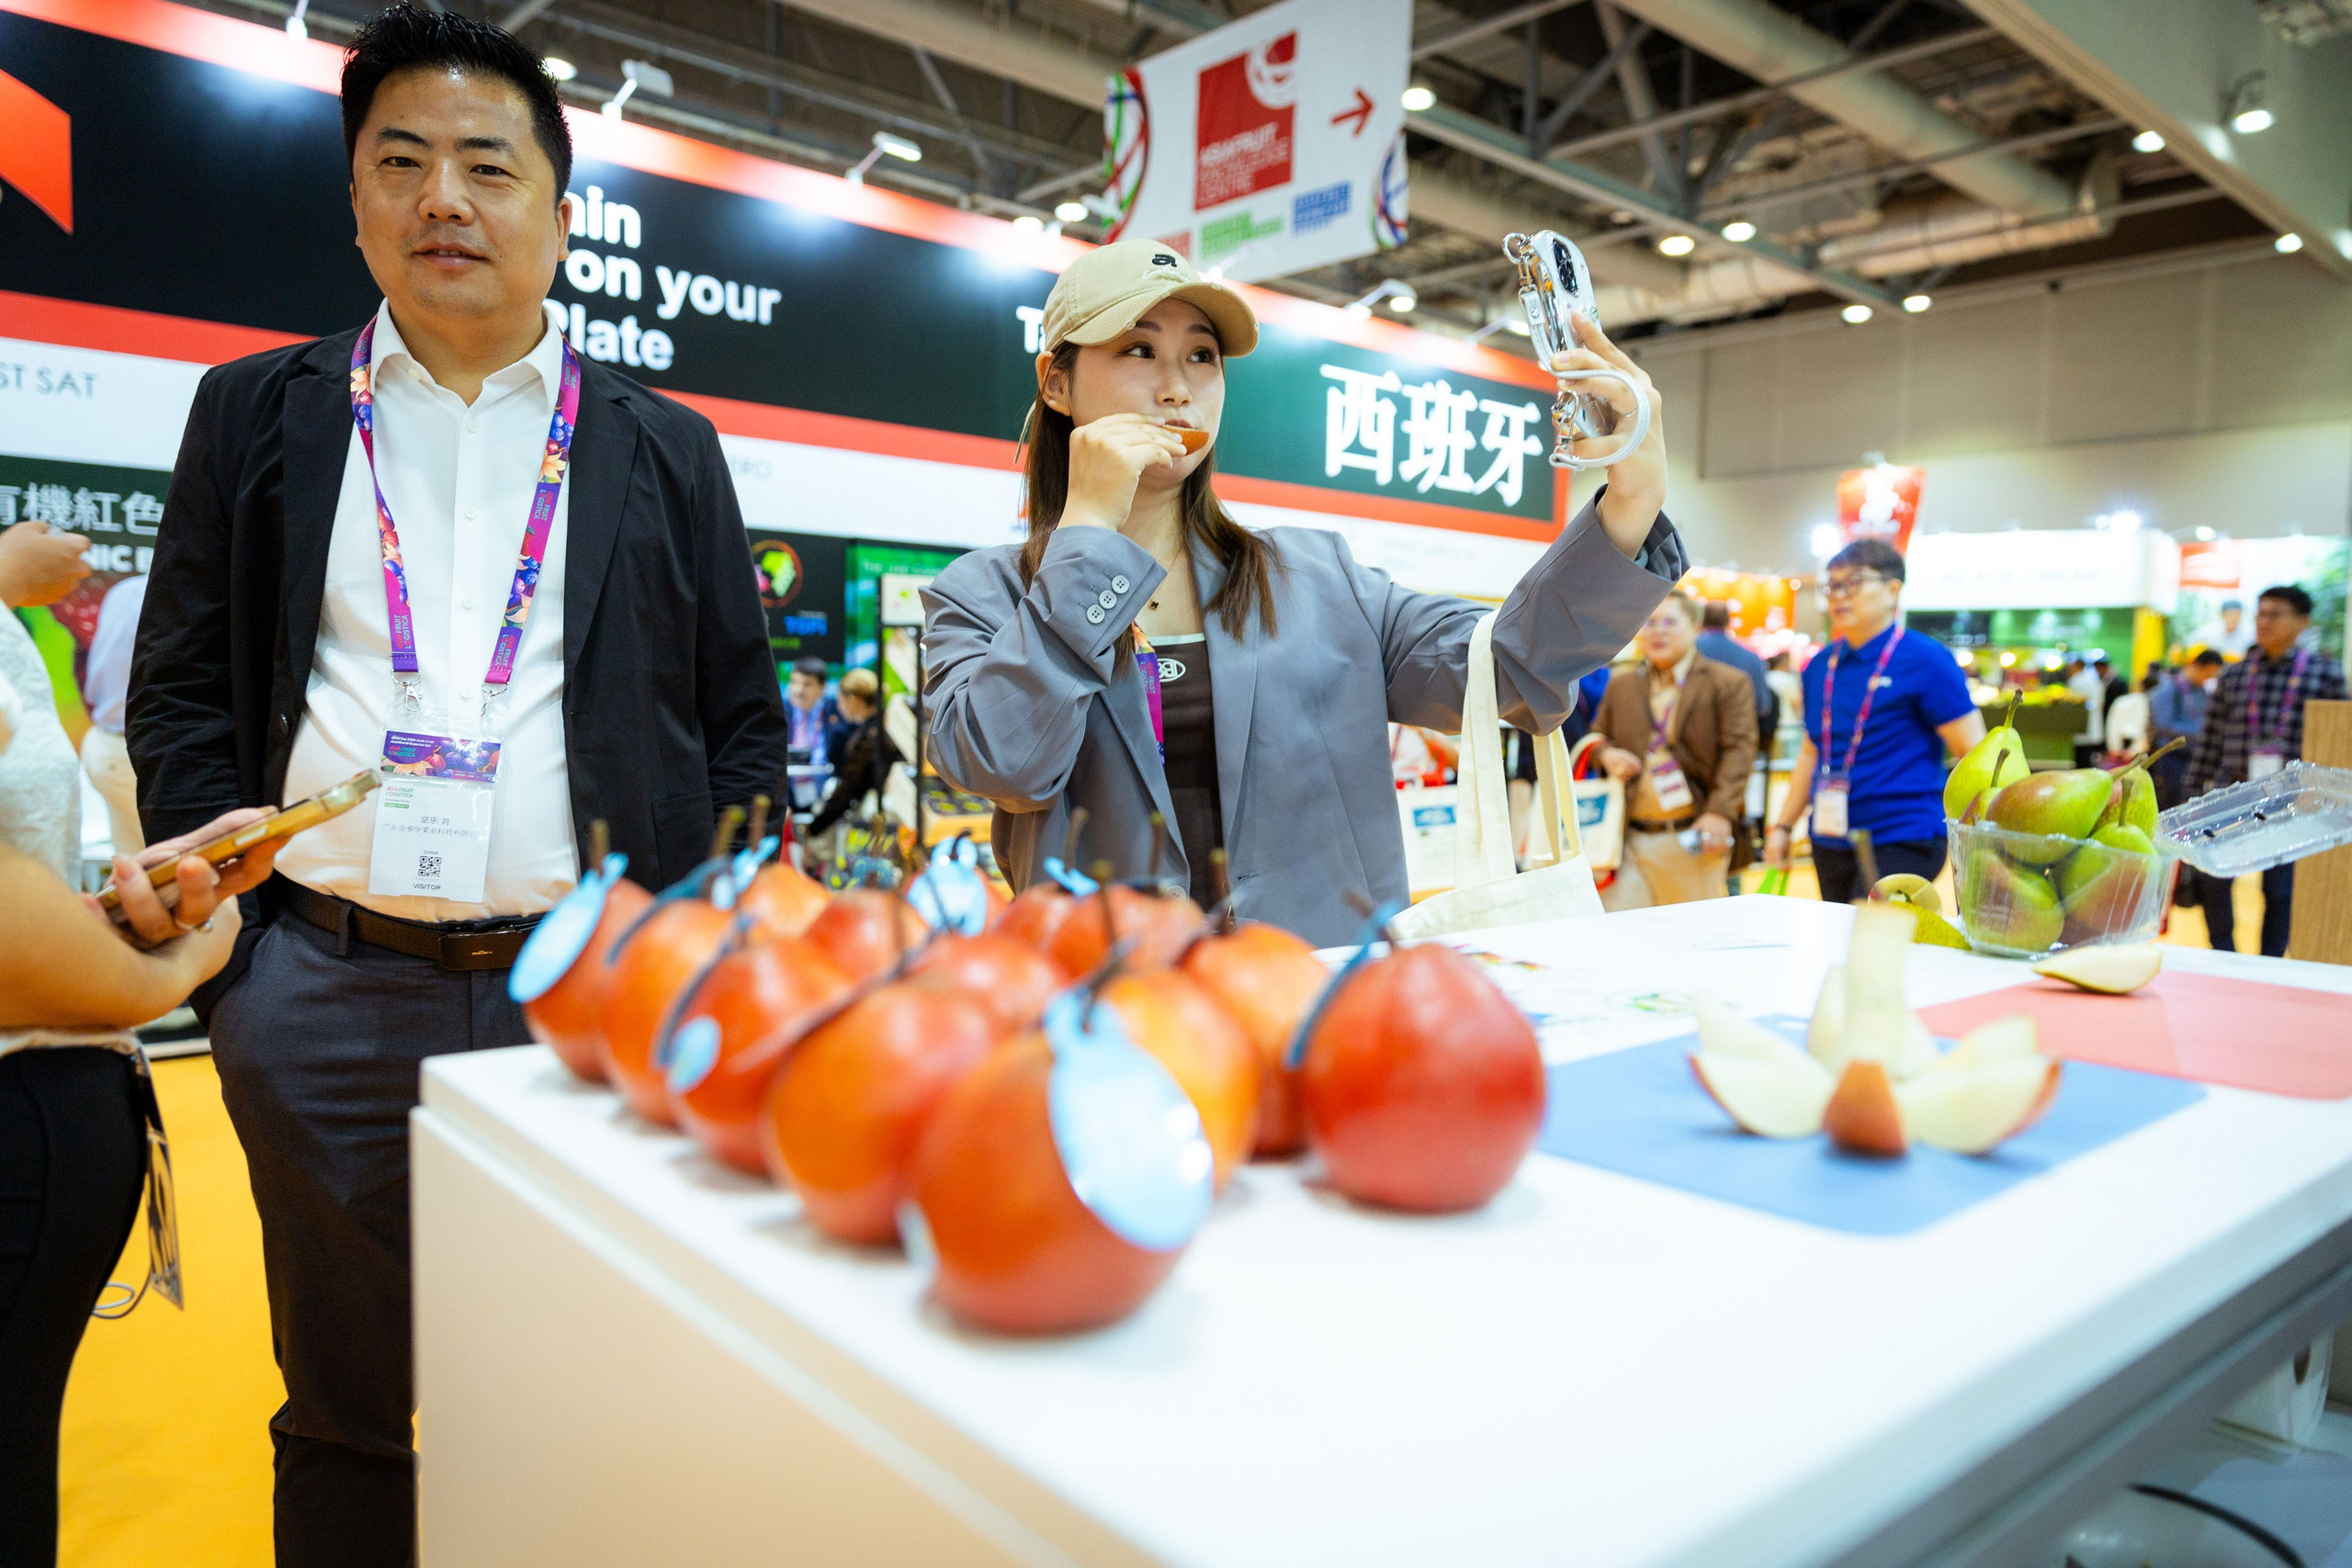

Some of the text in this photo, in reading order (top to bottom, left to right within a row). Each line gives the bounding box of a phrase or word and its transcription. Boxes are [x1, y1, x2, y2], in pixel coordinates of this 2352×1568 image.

[564, 249, 782, 326] on your
[37, 366, 97, 398] SAT
[1320, 364, 1544, 507] 西班牙
[534, 489, 547, 519] LOGISTICA
[540, 503, 550, 522] FRUIT
[393, 614, 402, 634] FRUIT
[401, 614, 413, 649] LOGISTICA
[502, 648, 512, 666] FRUIT
